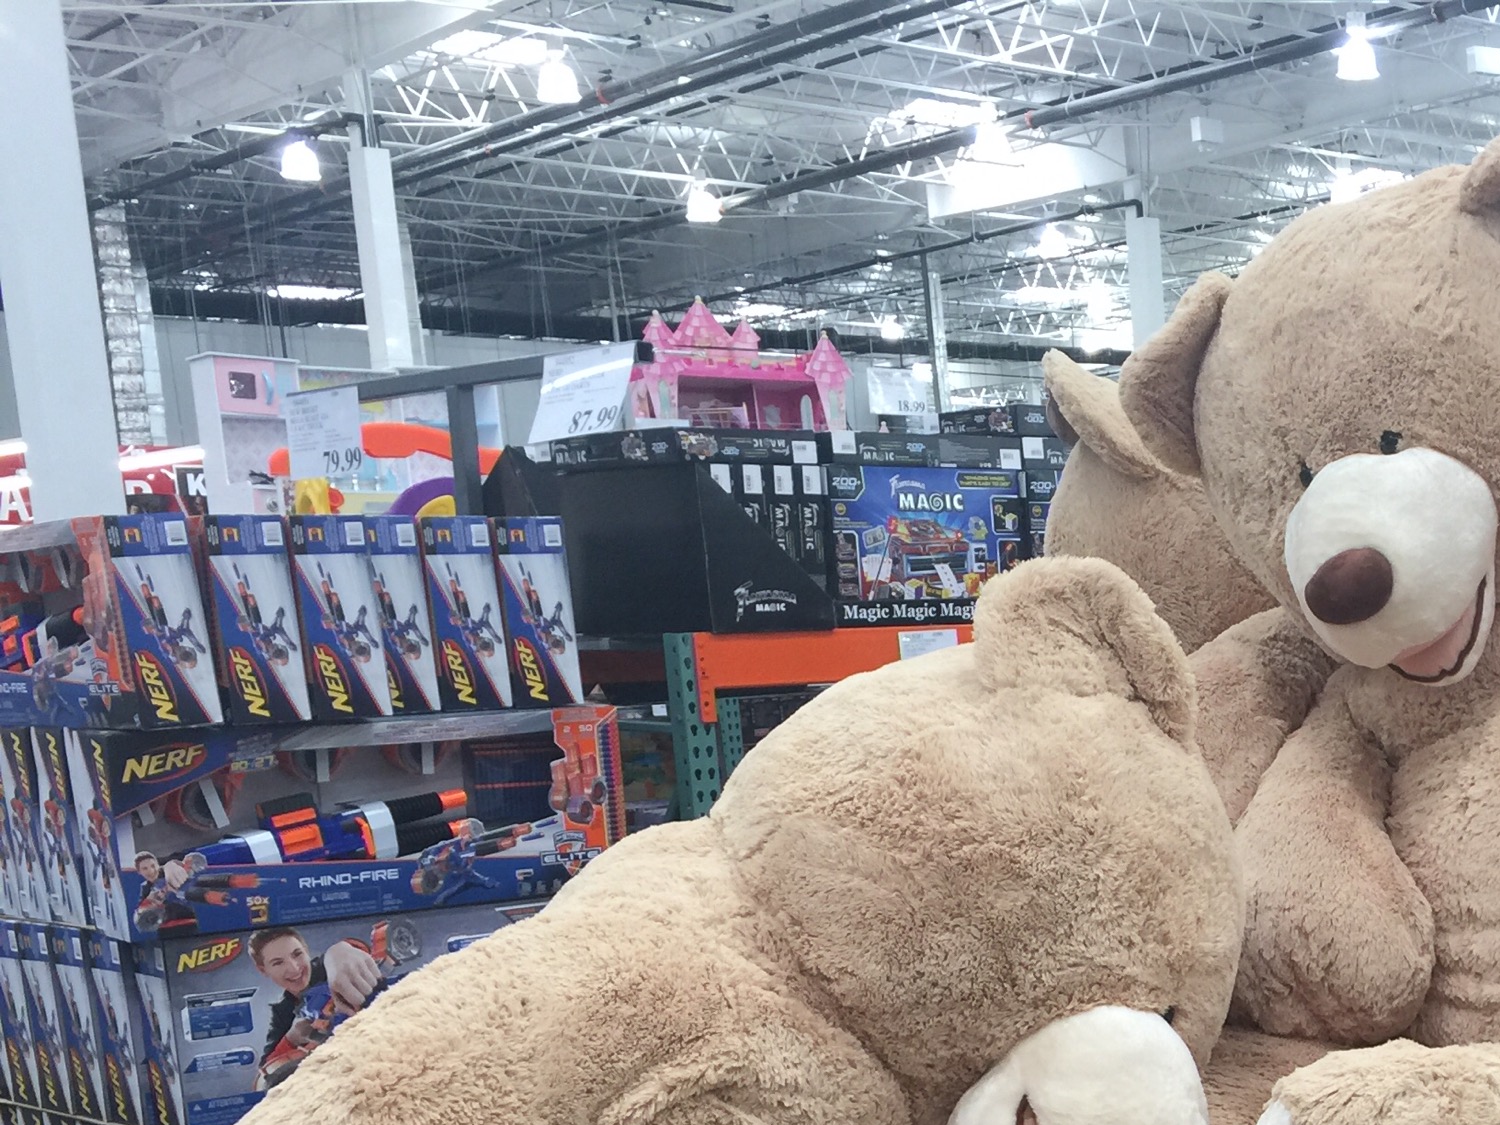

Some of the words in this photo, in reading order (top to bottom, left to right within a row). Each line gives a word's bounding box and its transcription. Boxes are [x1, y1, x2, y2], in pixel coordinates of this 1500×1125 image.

[568, 405, 618, 434] 87.99
[898, 400, 925, 413] 18.99
[323, 446, 361, 473] 79.99
[832, 477, 861, 486] 200+
[899, 493, 964, 511] MAGIC
[803, 507, 814, 550] MAGIC
[755, 603, 786, 612] MAGIC
[844, 604, 890, 622] Magic
[892, 602, 937, 621] Magic
[940, 602, 976, 620] Magi
[229, 648, 271, 717] NERF
[313, 645, 354, 713] NERF
[444, 640, 476, 705] NERF
[515, 637, 549, 702] NERF
[89, 684, 119, 693] ELITE
[135, 651, 181, 723] NERF
[122, 743, 204, 783] NERF
[543, 850, 599, 863] ELITE
[299, 868, 400, 888] RHINO-FIRE
[177, 938, 240, 973] NERF
